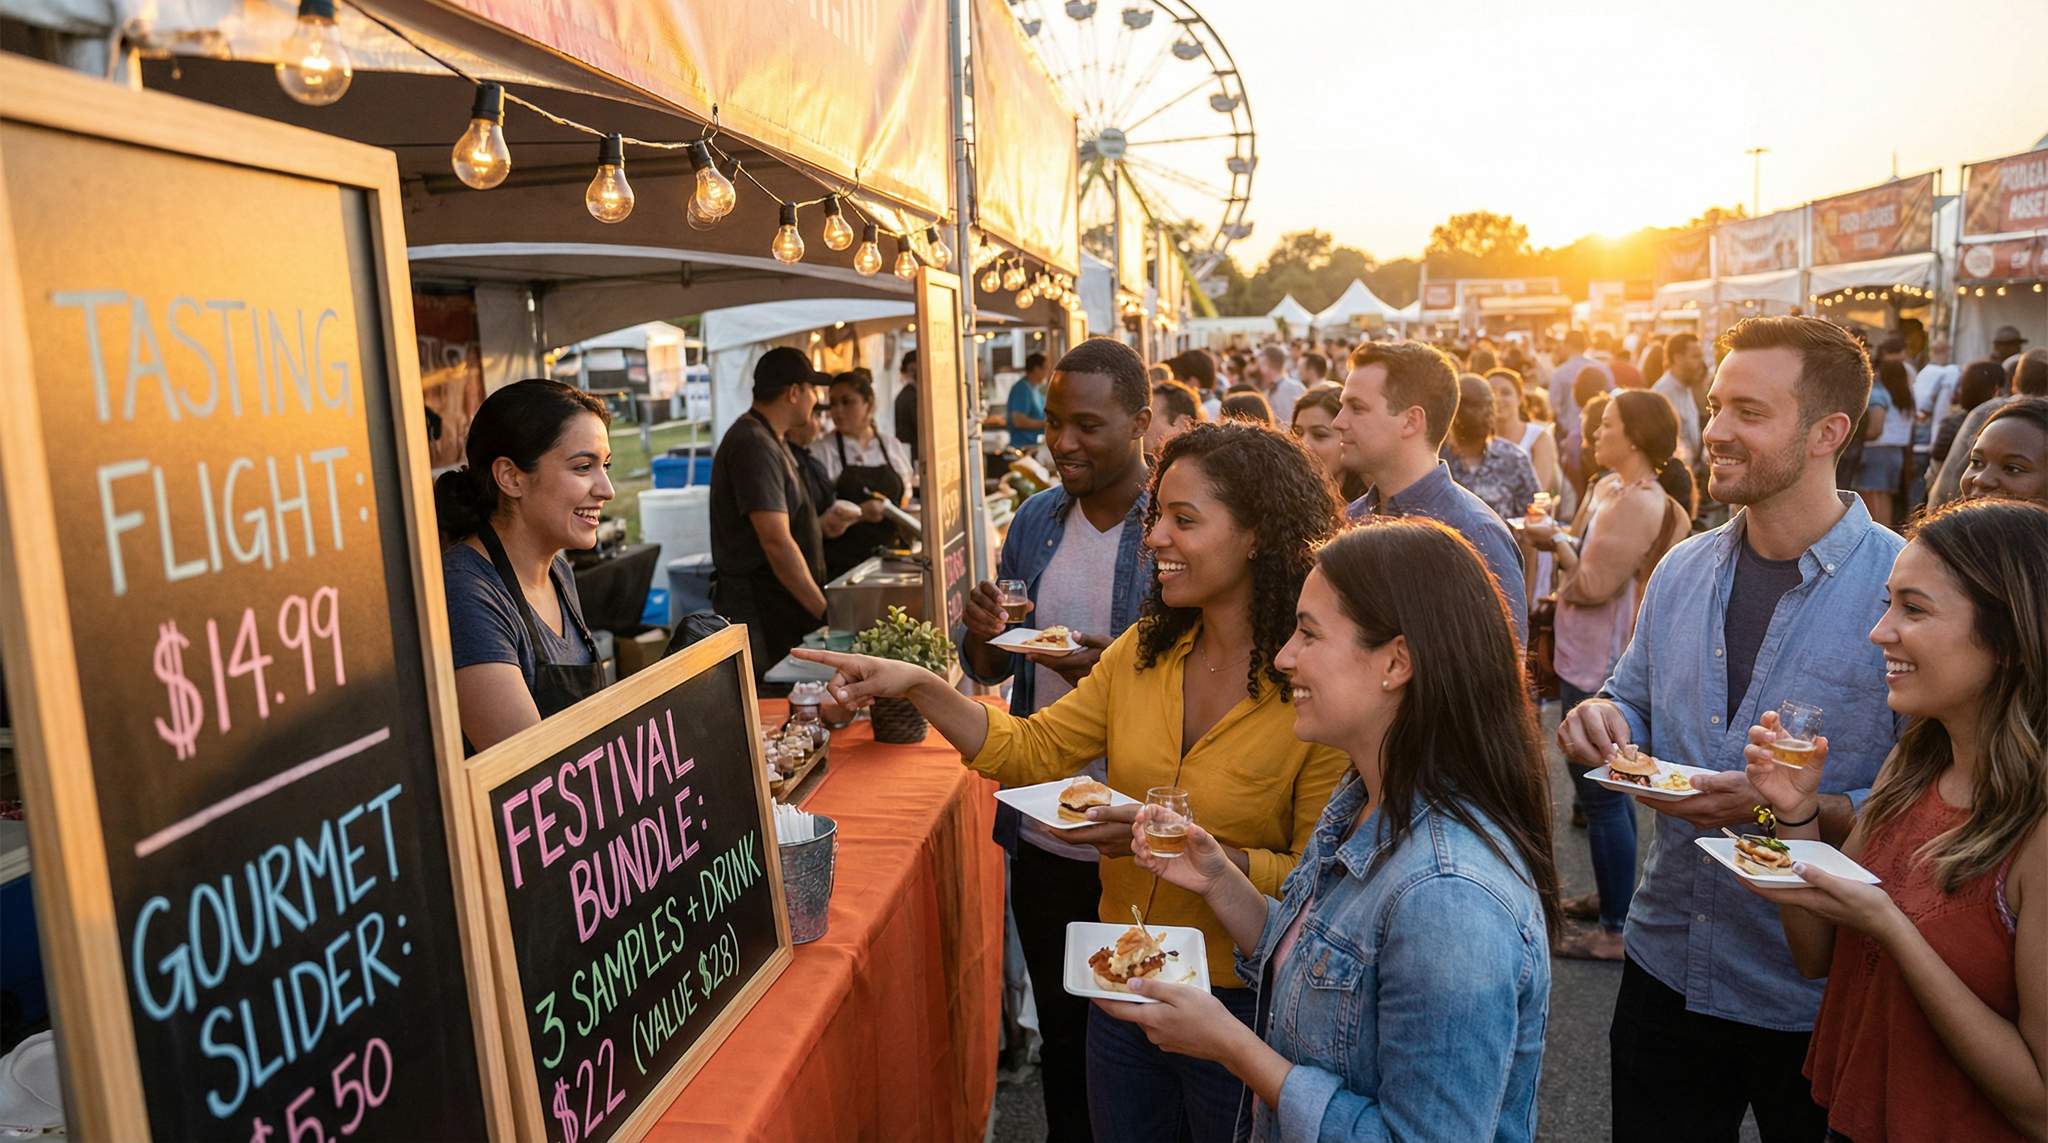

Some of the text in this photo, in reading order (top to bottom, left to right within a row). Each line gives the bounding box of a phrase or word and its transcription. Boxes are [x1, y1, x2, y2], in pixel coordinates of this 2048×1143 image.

[52, 289, 354, 423] TASTING
[98, 446, 369, 596] FLIGHT:
[153, 585, 347, 761] $14.99
[502, 707, 696, 890] FESTIVAL
[568, 785, 709, 944] BUNDLE:
[132, 783, 402, 1021] GOURMET
[535, 989, 566, 1070] 3
[571, 895, 686, 1037] SAMPLES
[699, 829, 762, 923] DRINK
[200, 911, 413, 1118] SLIDER:
[553, 922, 741, 1143] $22 (VALUE $28)
